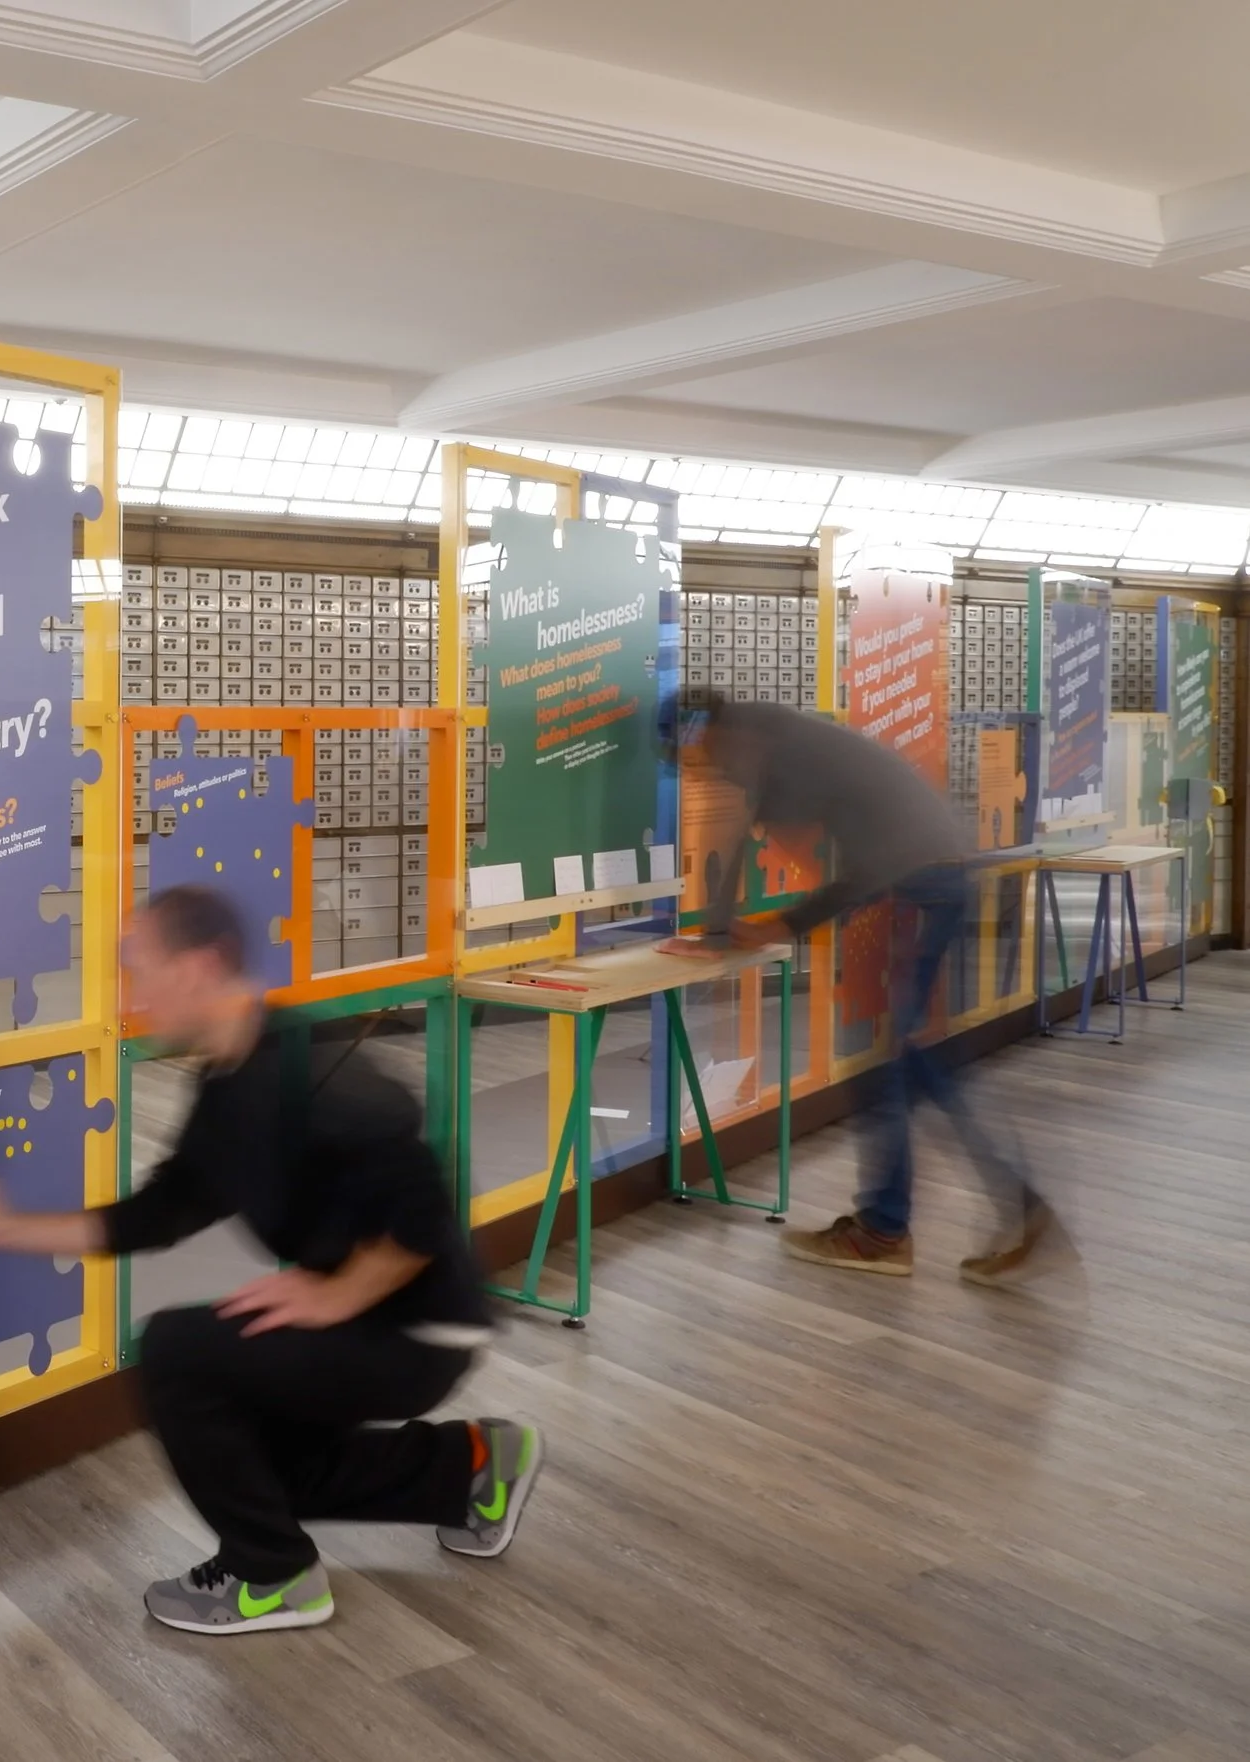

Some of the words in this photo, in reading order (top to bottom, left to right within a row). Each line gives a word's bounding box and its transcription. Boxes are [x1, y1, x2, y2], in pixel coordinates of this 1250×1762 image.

[500, 586, 544, 621] What
[547, 580, 559, 608] is
[537, 592, 645, 650] homelessness?
[855, 627, 883, 659] Would
[883, 629, 899, 659] you
[500, 664, 529, 688] What
[530, 658, 555, 678] does
[556, 637, 622, 670] homelessness
[537, 680, 565, 701] mean
[566, 675, 577, 691] to
[577, 662, 601, 692] you?
[854, 670, 864, 688] to
[865, 661, 882, 684] stay
[883, 657, 892, 674] in
[892, 648, 911, 676] your
[911, 638, 934, 663] home
[862, 690, 869, 713] if
[869, 687, 885, 716] you
[886, 666, 917, 700] needed
[894, 696, 913, 722] with
[913, 692, 932, 719] your
[894, 728, 912, 750] own
[913, 712, 934, 740] care?
[155, 771, 184, 791] Beliefs
[174, 784, 198, 798] Religion,
[198, 776, 221, 790] attitudes
[221, 774, 228, 782] or
[228, 768, 247, 782] politics
[2, 836, 10, 845] to
[11, 832, 22, 843] the
[22, 824, 46, 838] answer
[8, 843, 23, 855] with
[24, 837, 43, 850] most.
